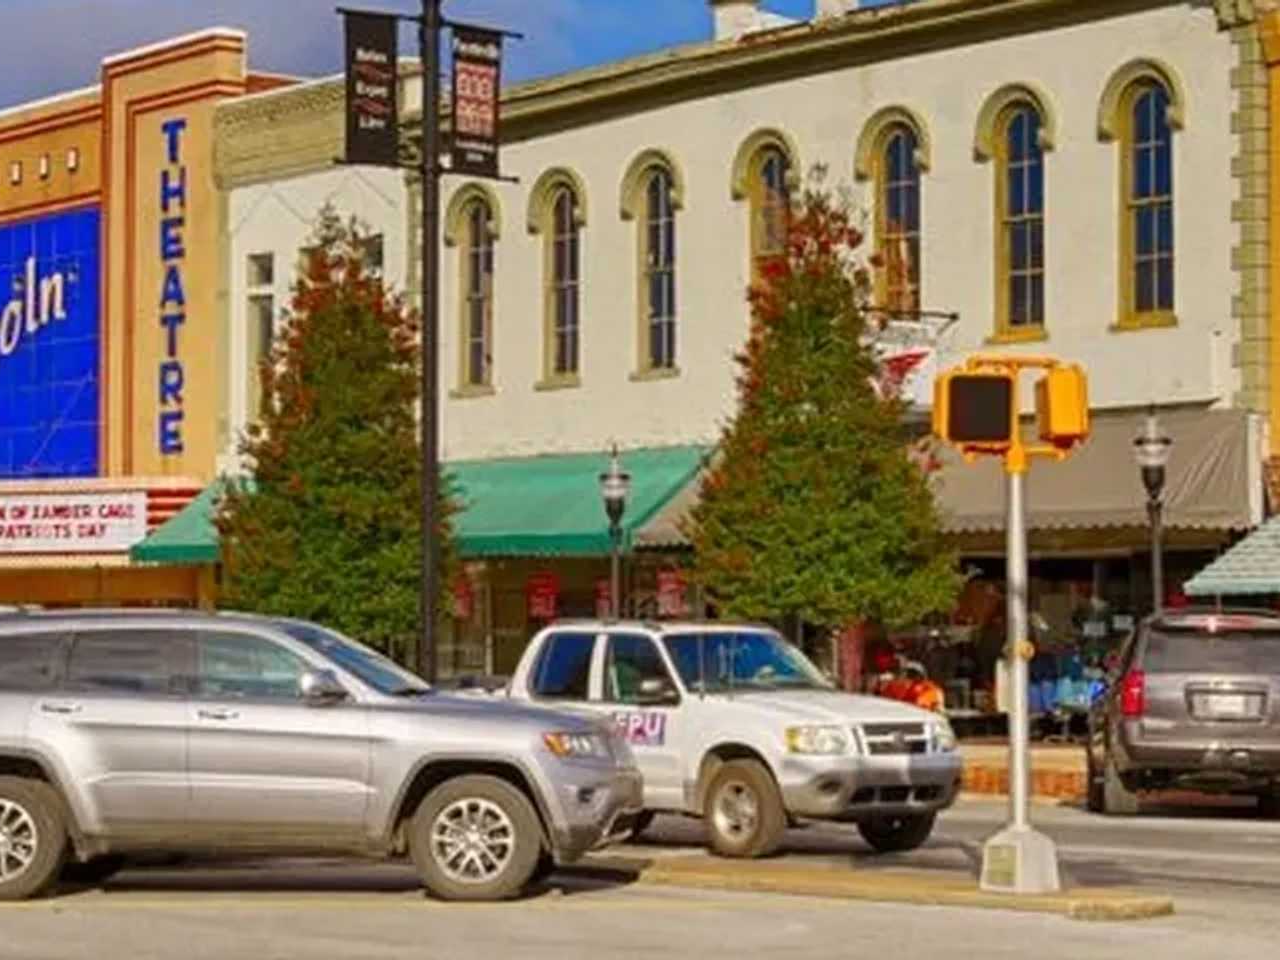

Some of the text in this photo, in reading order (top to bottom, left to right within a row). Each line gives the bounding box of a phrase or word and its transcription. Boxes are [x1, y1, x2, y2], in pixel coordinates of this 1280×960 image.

[160, 118, 186, 455] THEATRE
[10, 504, 28, 520] OF
[77, 523, 107, 538] DAY
